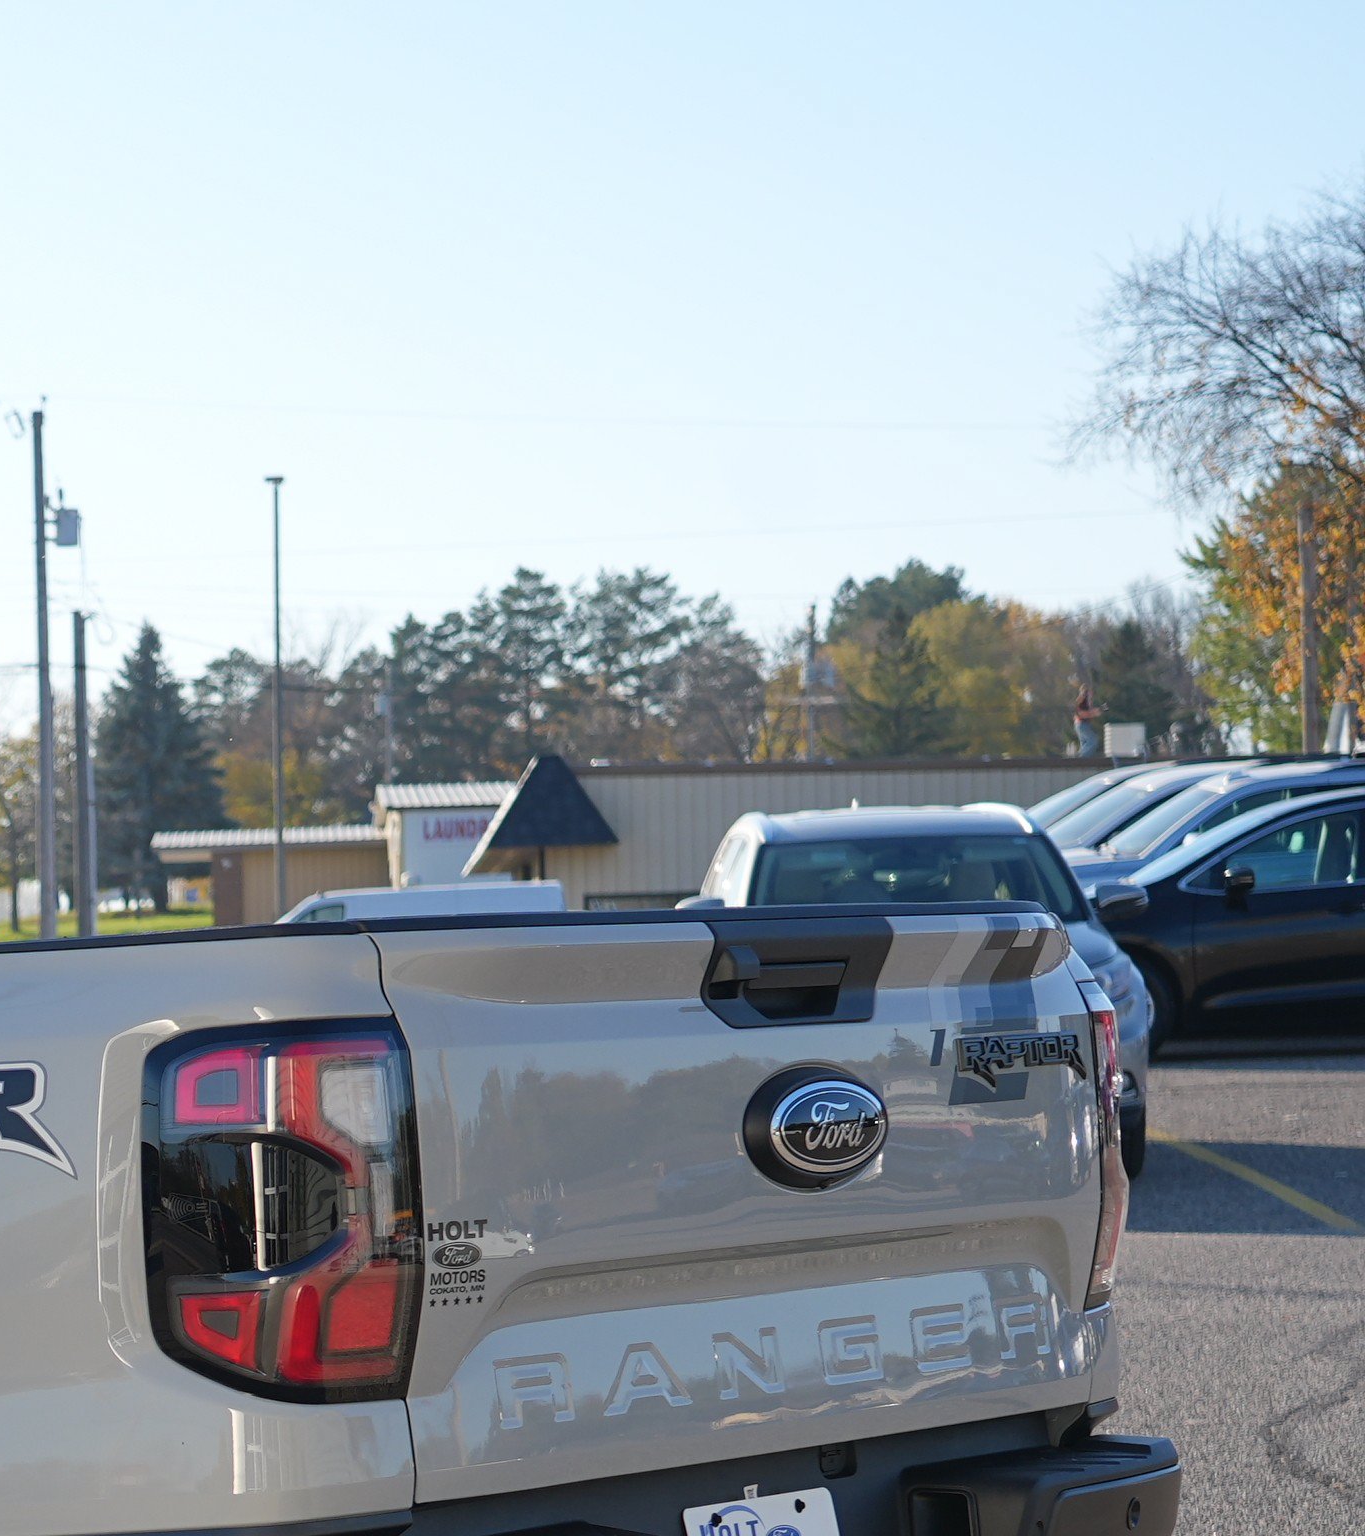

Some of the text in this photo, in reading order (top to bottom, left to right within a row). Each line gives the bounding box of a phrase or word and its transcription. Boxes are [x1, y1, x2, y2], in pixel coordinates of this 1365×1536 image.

[953, 1031, 1086, 1092] RAPTOR
[805, 1100, 866, 1151] Ford
[427, 1219, 488, 1241] HOLT
[441, 1245, 473, 1265] Ford
[430, 1269, 486, 1286] MOTORS
[429, 1284, 486, 1296] COKATO, MN
[492, 1293, 1051, 1430] RANGER
